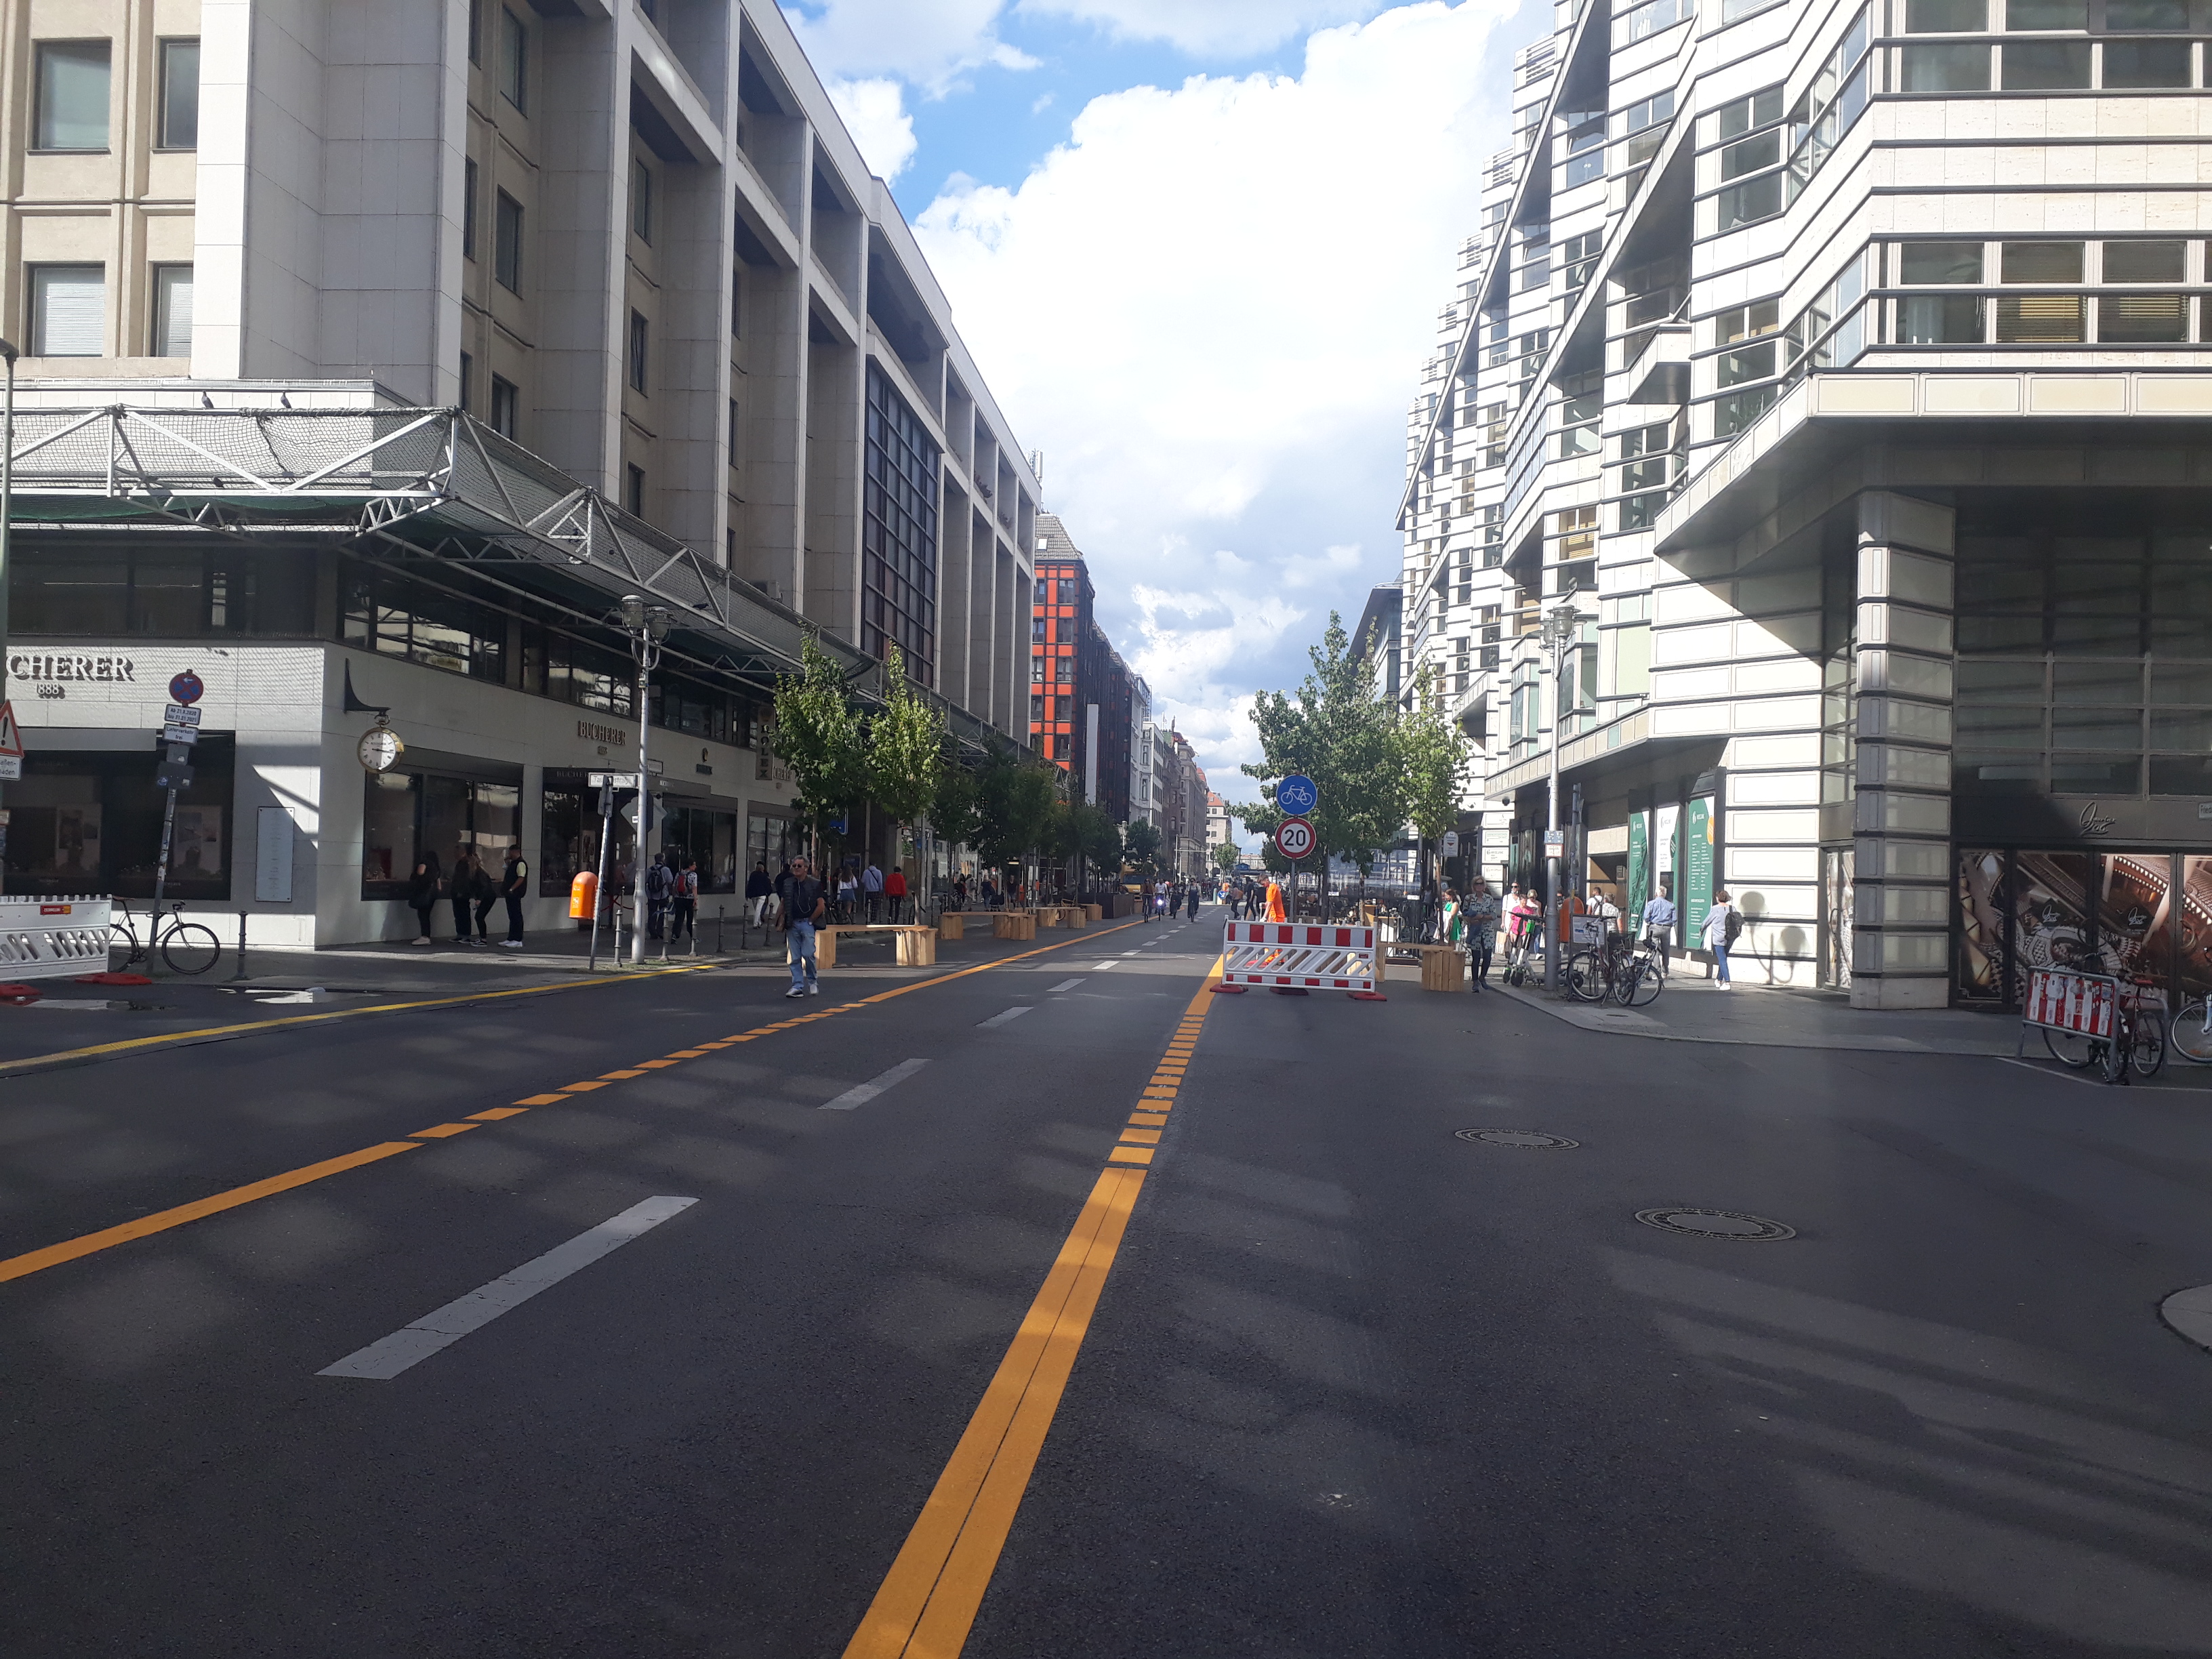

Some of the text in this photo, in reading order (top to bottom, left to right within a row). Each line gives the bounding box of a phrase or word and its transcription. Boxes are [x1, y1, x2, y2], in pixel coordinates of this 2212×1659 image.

[5, 653, 132, 678] CHERER
[36, 682, 61, 696] 1888
[578, 720, 626, 746] BUCHERER
[760, 725, 770, 777] ROLEX
[1284, 829, 1306, 846] 20
